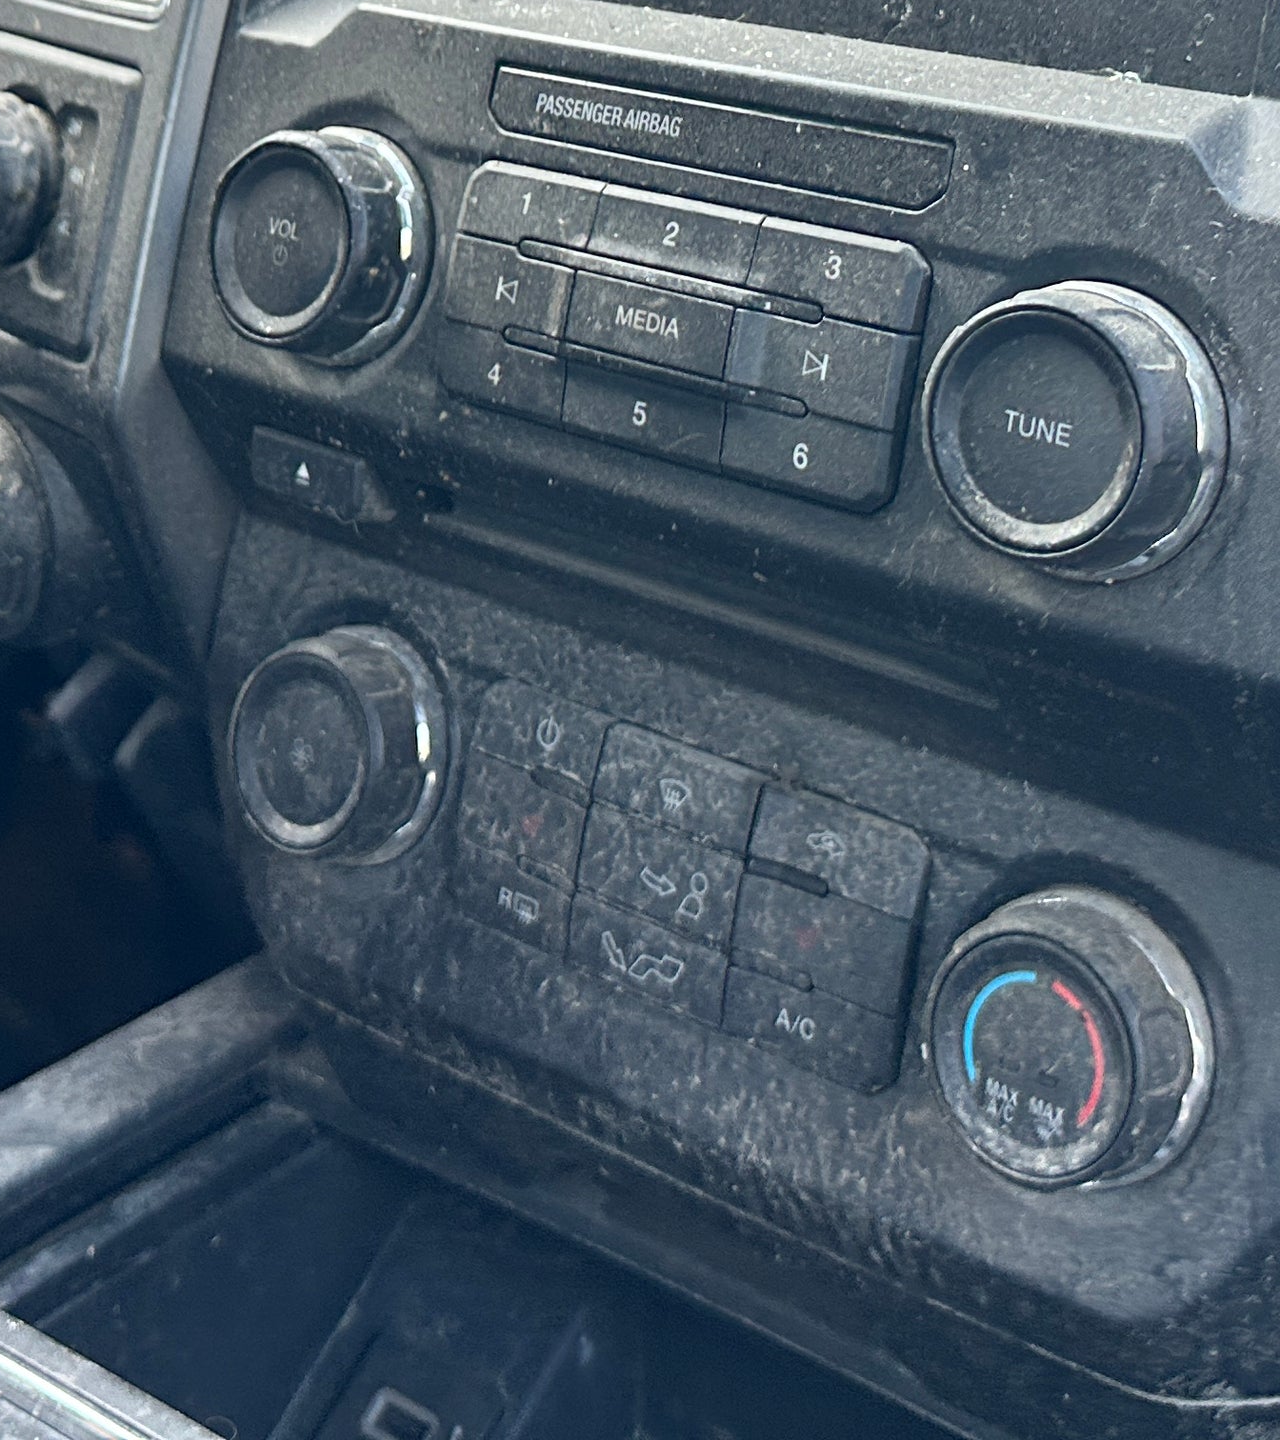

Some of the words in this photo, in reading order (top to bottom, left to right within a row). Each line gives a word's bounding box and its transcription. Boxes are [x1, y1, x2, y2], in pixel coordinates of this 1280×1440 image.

[535, 92, 623, 127] PASSENGER
[622, 108, 684, 138] AIRBAG
[521, 192, 533, 215] 1
[270, 215, 299, 242] VOL
[662, 221, 680, 248] 2
[824, 254, 843, 281] 3
[614, 304, 680, 340] MEDIA
[486, 362, 502, 387] 4
[632, 400, 648, 427] 5
[1004, 409, 1074, 448] TUNE
[792, 442, 809, 471] 6
[774, 1006, 817, 1041] A/C
[984, 1076, 1019, 1108] MAX
[1028, 1095, 1066, 1128] MAX
